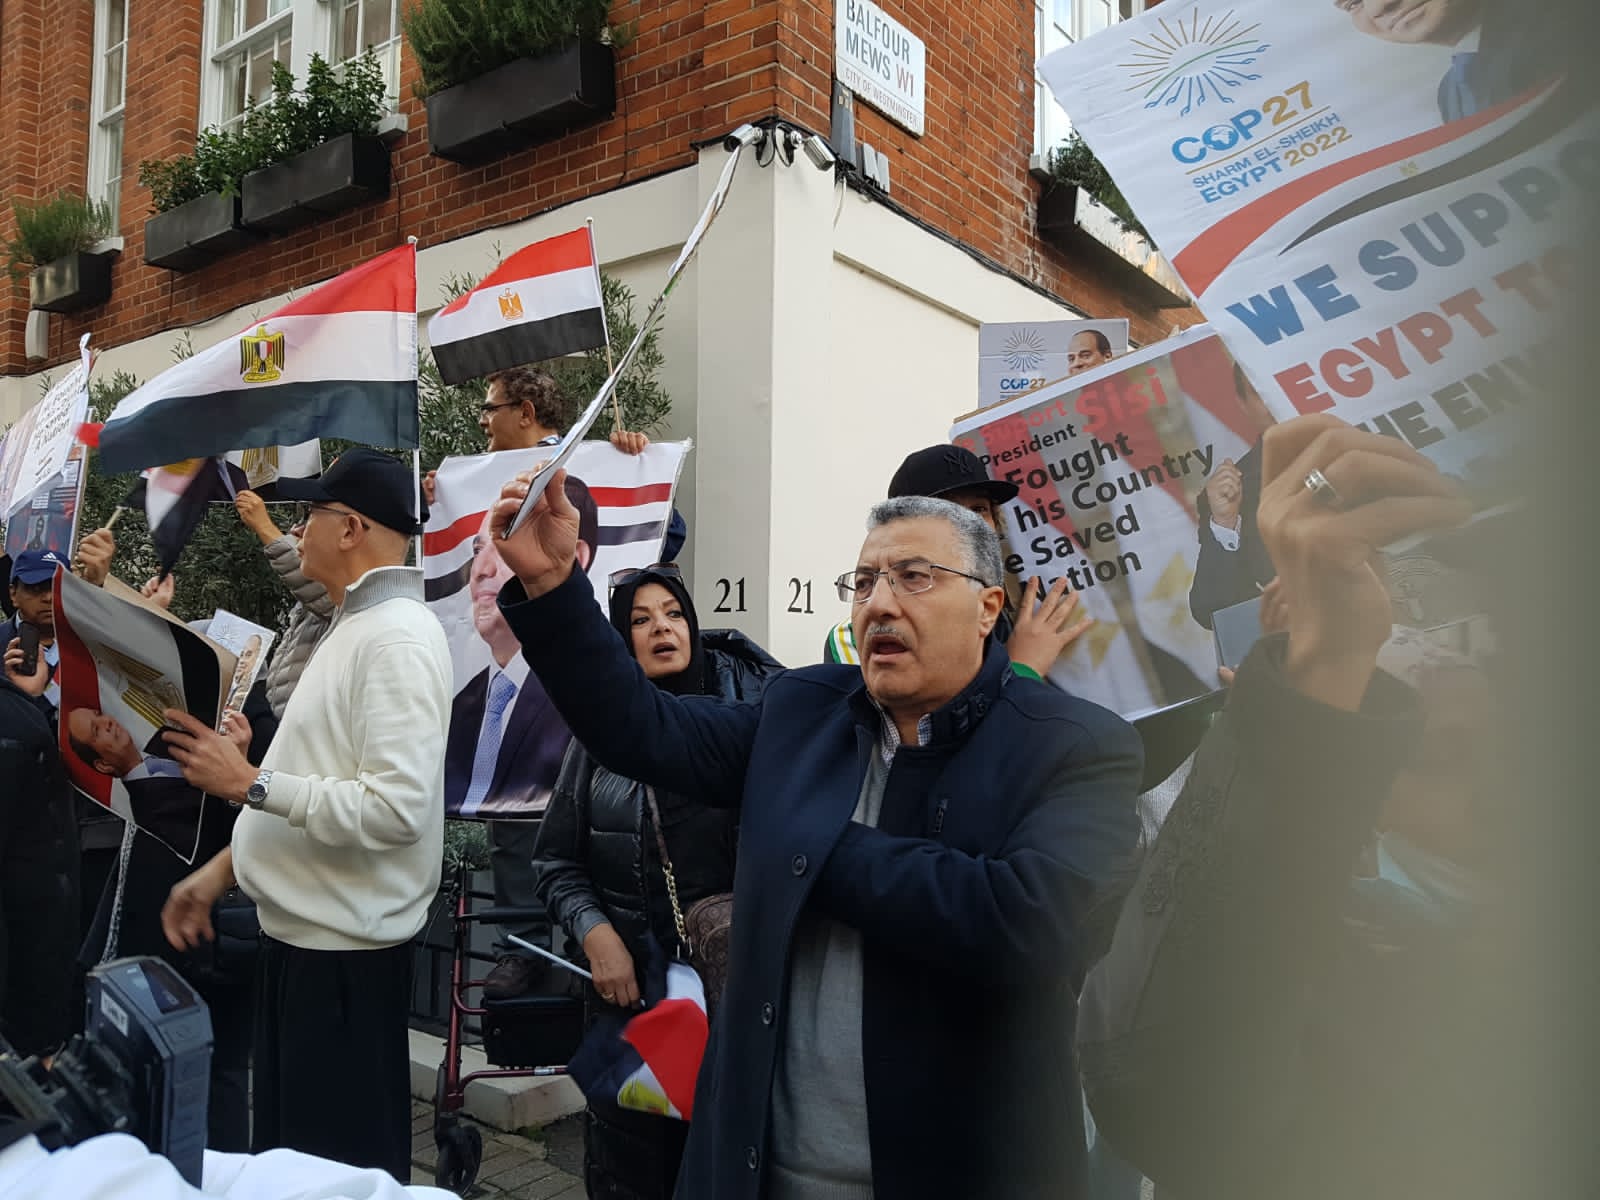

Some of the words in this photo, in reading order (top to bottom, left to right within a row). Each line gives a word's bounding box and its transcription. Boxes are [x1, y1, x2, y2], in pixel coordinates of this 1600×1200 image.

[846, 0, 910, 65] BALFOUR
[846, 27, 890, 81] MEWS
[896, 63, 914, 98] W1
[845, 67, 860, 86] CITY
[862, 79, 872, 92] OF
[873, 84, 921, 130] WESTMINSTER
[1172, 80, 1313, 164] COP27
[1193, 157, 1252, 188] SHARM
[1254, 112, 1342, 162] EL-SHEIKH
[1200, 157, 1283, 203] EGYPT
[1283, 126, 1353, 167] 2022
[1224, 263, 1361, 346] WE
[999, 377, 1047, 391] COP27
[1273, 287, 1498, 417] EGYPT
[1074, 367, 1169, 433] Sisi
[979, 422, 1078, 468] President
[1004, 431, 1134, 491] Fought
[1013, 498, 1066, 533] his
[1071, 443, 1215, 511] Country
[1030, 504, 1142, 567] Saved
[713, 577, 748, 613] 21
[787, 577, 815, 614] 21
